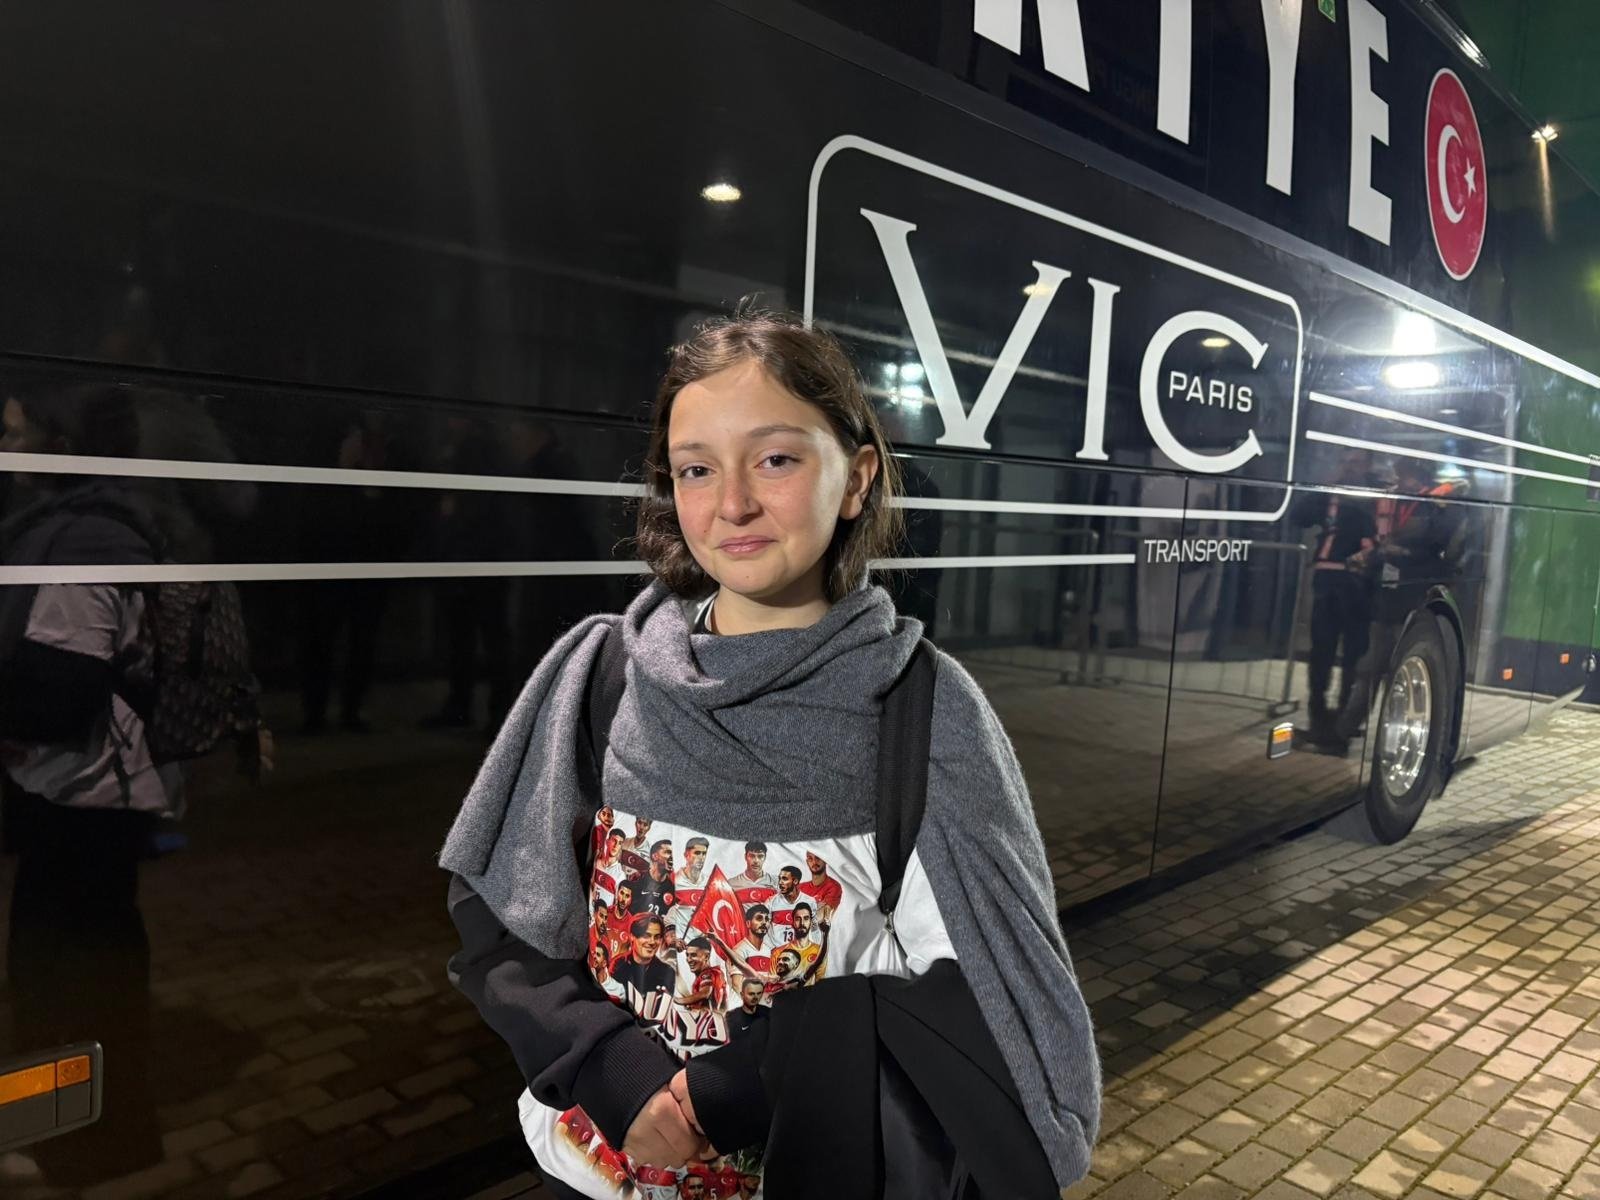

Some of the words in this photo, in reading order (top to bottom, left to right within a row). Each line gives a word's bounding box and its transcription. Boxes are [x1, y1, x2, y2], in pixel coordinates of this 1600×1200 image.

[861, 208, 1269, 474] VIC
[1168, 371, 1253, 413] PARIS
[1144, 539, 1252, 563] TRANSPORT
[783, 931, 794, 942] 13
